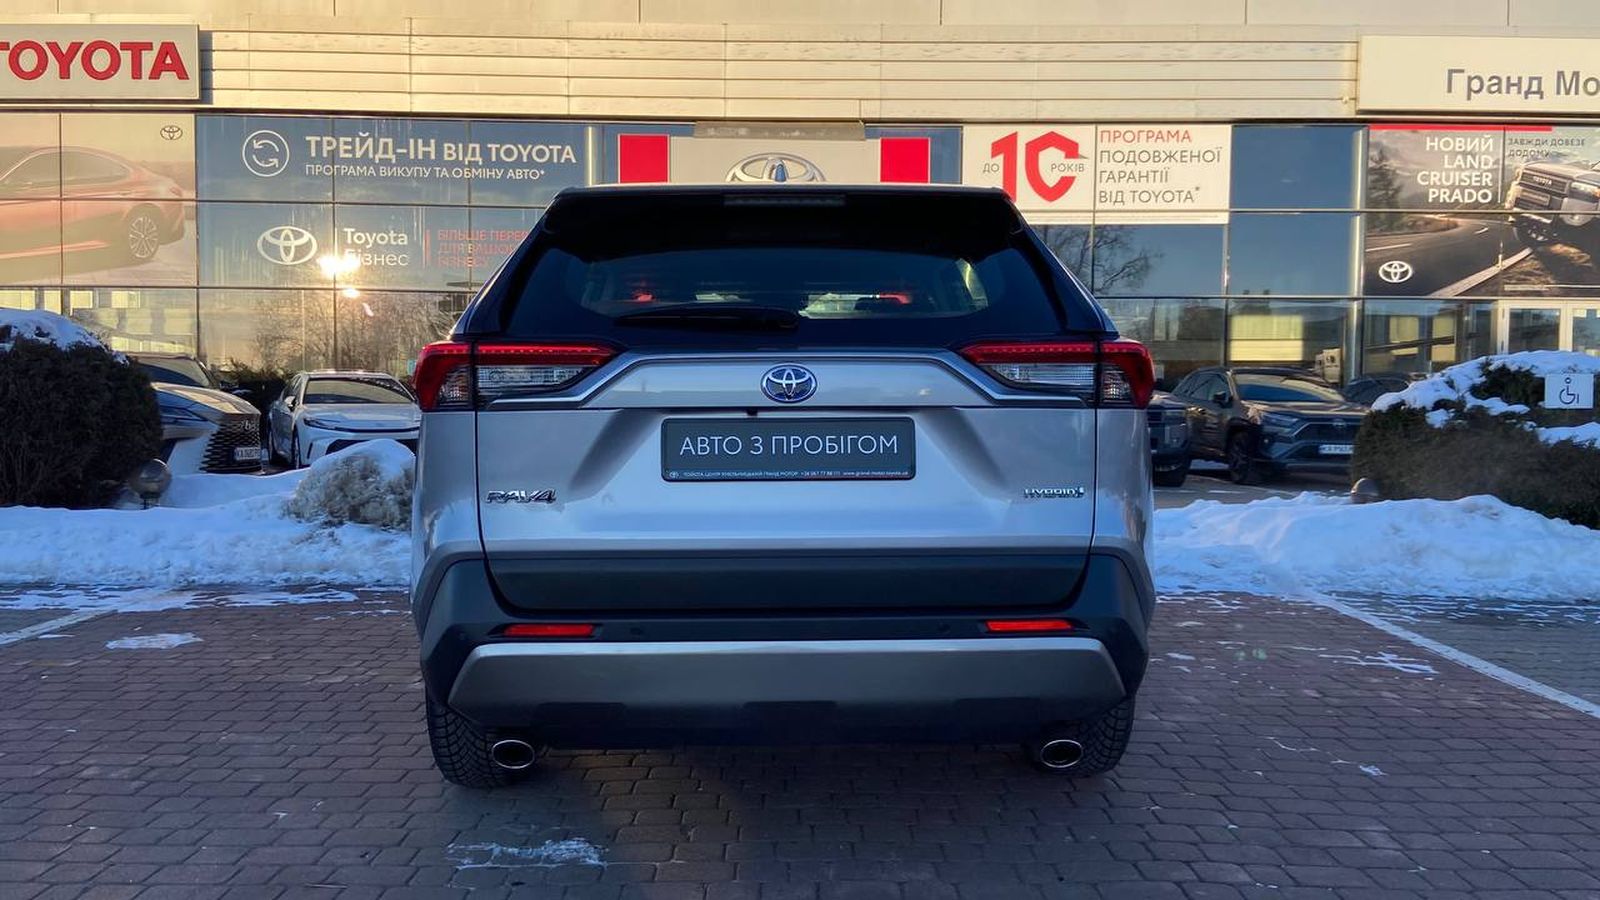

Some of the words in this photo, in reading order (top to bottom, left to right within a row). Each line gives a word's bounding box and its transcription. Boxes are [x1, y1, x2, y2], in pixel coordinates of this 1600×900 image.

[0, 40, 190, 80] OYOTA
[1446, 68, 1544, 101] Гранд
[1100, 130, 1192, 143] ПРОГРАМА
[1426, 135, 1493, 152] НОВИЙ
[1508, 138, 1548, 147] ЗАВЖДИ
[305, 132, 436, 163] ТРЕЙД-ІН
[443, 143, 482, 165] ВІД
[488, 144, 577, 163] TOYOTA
[1100, 147, 1222, 164] ПОДОВЖЕНОЇ
[1508, 149, 1550, 158] ДОДОМУ
[983, 163, 1000, 174] ДО
[1051, 163, 1085, 173] РОКІВ
[1444, 155, 1493, 169] LAND
[305, 164, 376, 177] ПРОГРАМА
[380, 167, 431, 178] ВИКУПУ
[432, 168, 449, 178] ТА
[451, 168, 504, 179] ОБМІНУ
[1100, 167, 1169, 183] ГАРАНТІЇ
[1416, 171, 1493, 187] CRUISER
[1099, 190, 1125, 205] ВІД
[1428, 188, 1492, 203] PRADO
[343, 228, 408, 249] Toyota
[680, 435, 743, 455] АВТО
[750, 435, 764, 455] З
[771, 434, 898, 455] ПРОБІГОМ
[485, 489, 557, 504] RAV4
